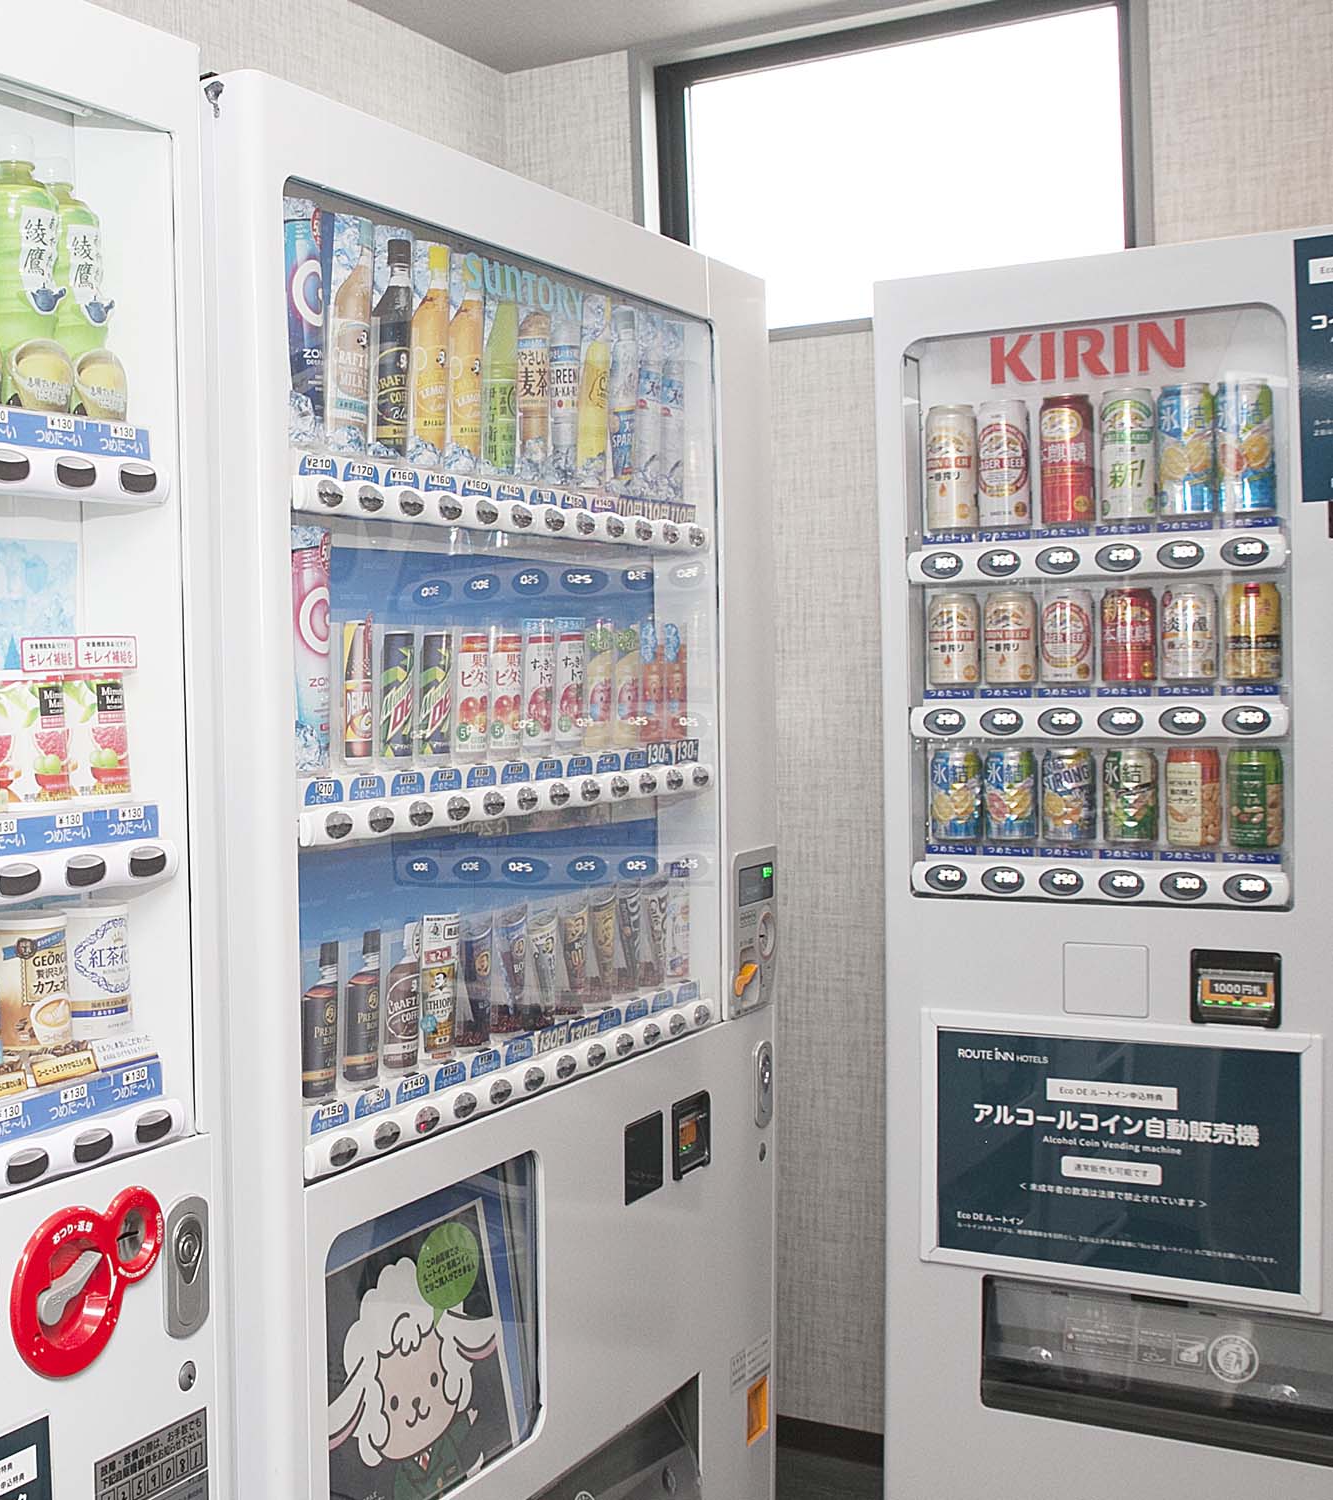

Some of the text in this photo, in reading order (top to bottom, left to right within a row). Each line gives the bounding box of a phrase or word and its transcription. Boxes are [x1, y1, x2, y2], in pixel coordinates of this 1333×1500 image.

[23, 218, 49, 277] 綾鷹
[72, 235, 94, 290] 綾鷹
[466, 252, 584, 321] SUNTORY
[989, 317, 1186, 385] KIRIN
[518, 367, 549, 398] 麦茶
[307, 456, 331, 469] ¥210
[391, 469, 414, 482] ¥160
[430, 474, 451, 485] ¥160
[1045, 766, 1091, 790] STRONG
[937, 869, 961, 881] 250
[1052, 873, 1078, 885] 250
[957, 1047, 994, 1061] ROUTE
[1016, 1054, 1050, 1065] HOTELS
[403, 1077, 425, 1090] ¥140
[1059, 1086, 1164, 1102] Eco DE ルートイン申込特典
[320, 1104, 344, 1116] ¥150
[973, 1103, 1261, 1148] アルコールコイン自動販売機
[1042, 1135, 1183, 1156] Alcohol Coin Vending machine
[1074, 1162, 1149, 1179] 通常販売も可能です
[956, 1210, 1025, 1226] Eco DE ルートイン
